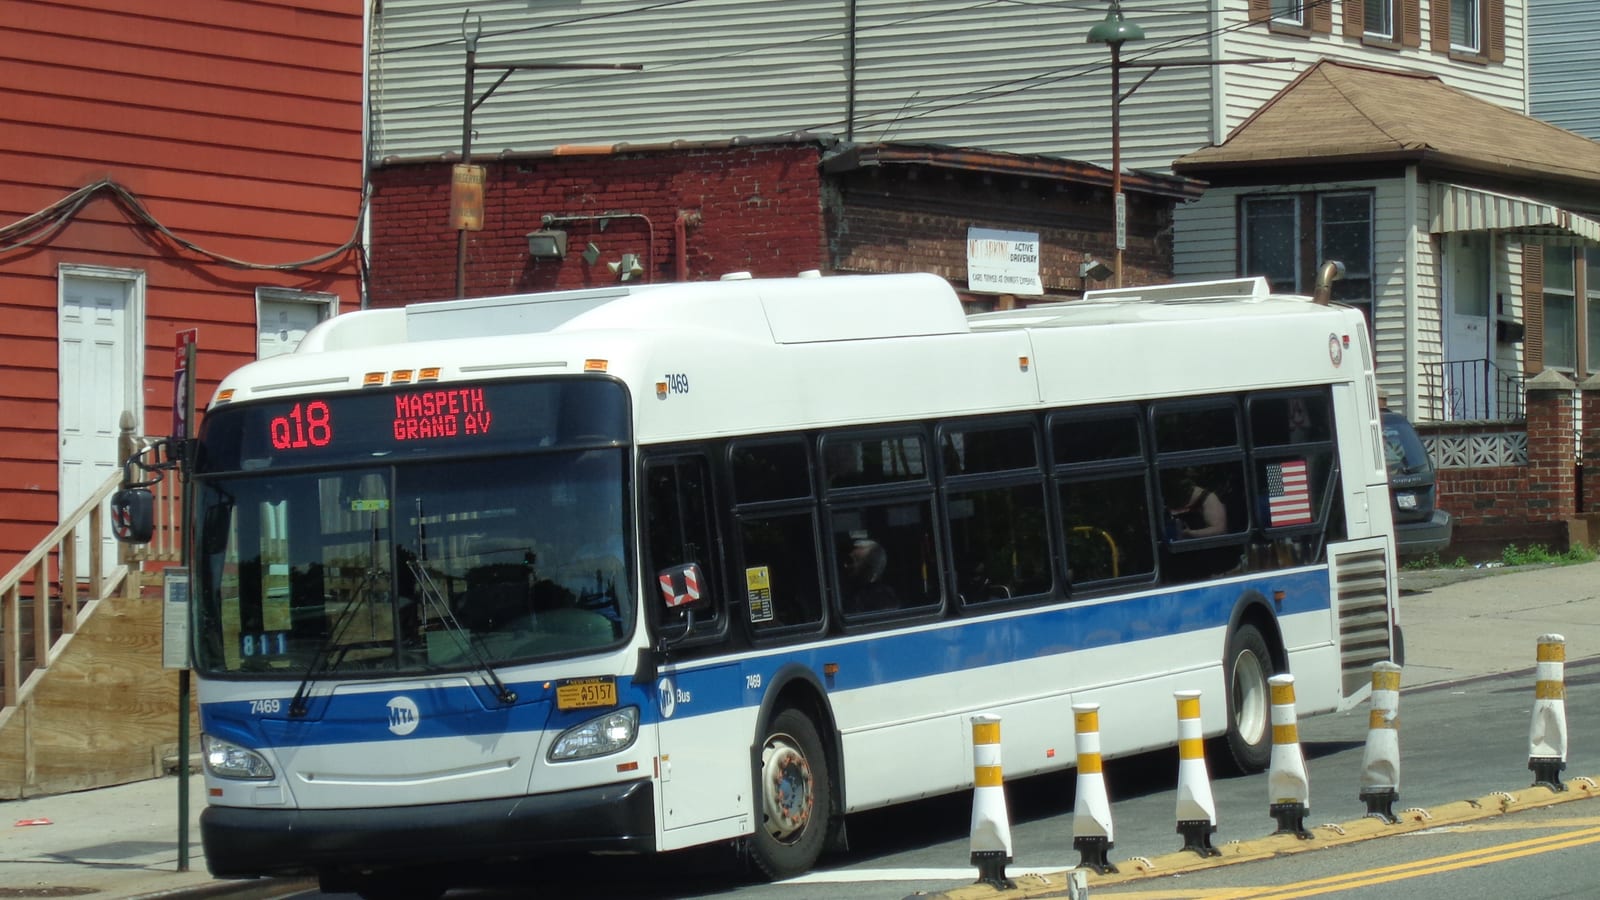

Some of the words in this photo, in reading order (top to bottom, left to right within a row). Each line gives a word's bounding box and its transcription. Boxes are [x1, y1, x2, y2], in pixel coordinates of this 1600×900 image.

[1014, 242, 1034, 253] ACTIVE
[1010, 253, 1037, 263] DRIVEWAY
[665, 374, 689, 394] 7469
[394, 388, 484, 418] MASPETH
[271, 401, 331, 449] Q18
[393, 414, 458, 440] GRAND
[464, 411, 492, 435] AV
[745, 674, 761, 689] 7469
[587, 684, 611, 701] 5157
[676, 688, 691, 703] Bus
[249, 699, 280, 714] 7469
[387, 705, 414, 727] MTA
